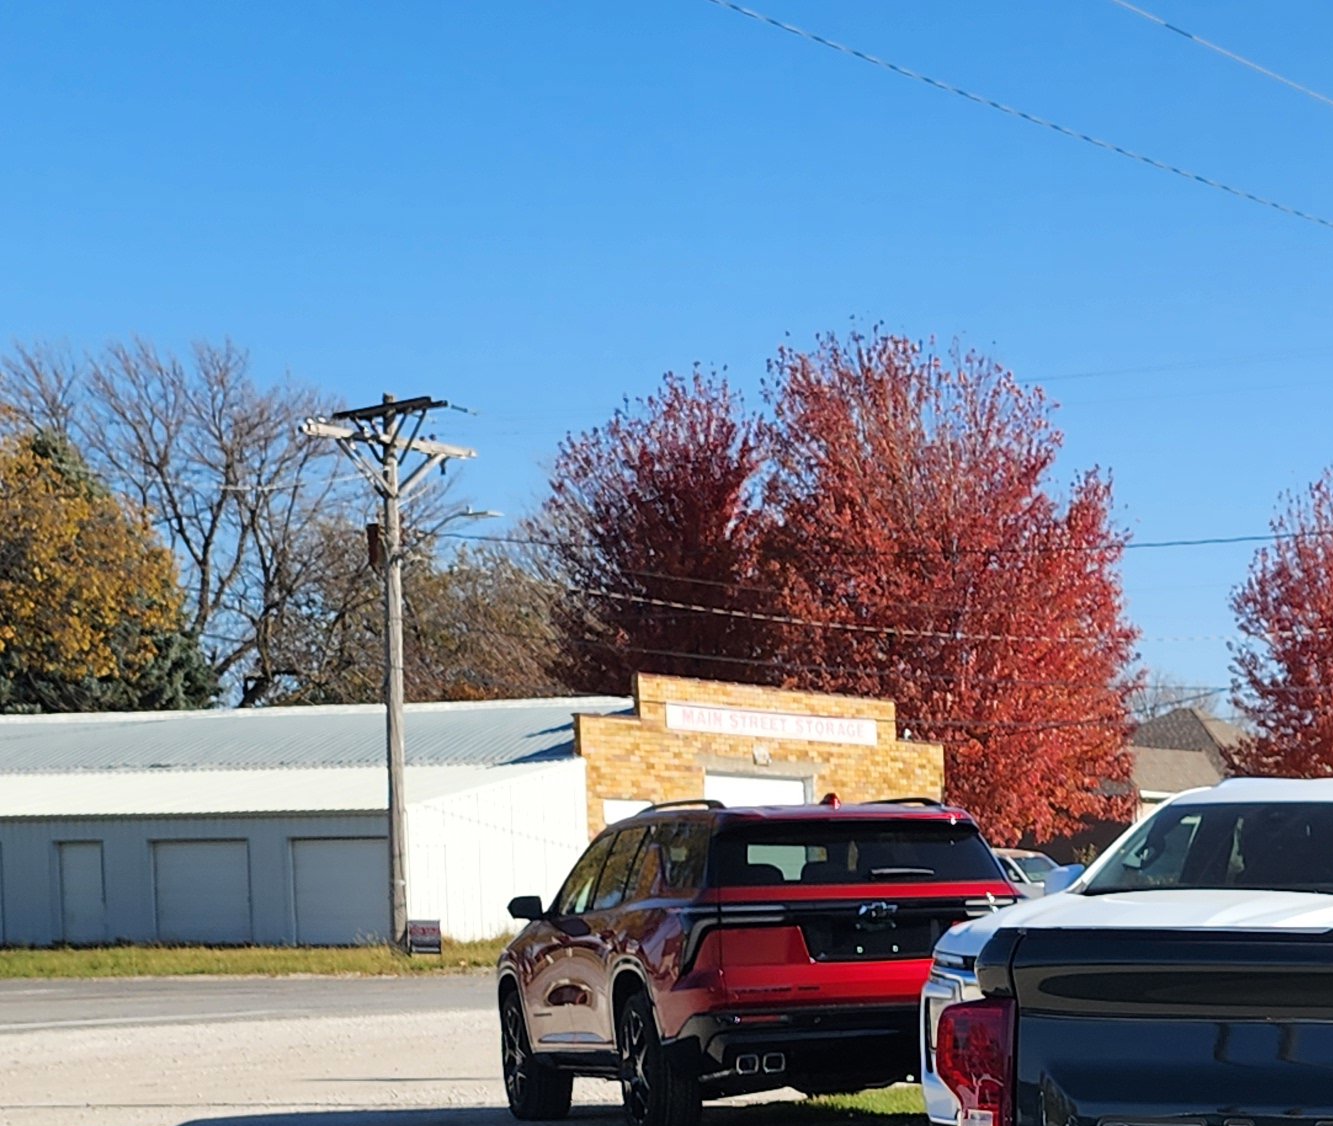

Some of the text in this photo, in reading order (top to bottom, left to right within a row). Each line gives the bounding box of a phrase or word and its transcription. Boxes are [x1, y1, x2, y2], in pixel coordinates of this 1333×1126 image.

[682, 708, 865, 738] MAIN STREET STORAGE
